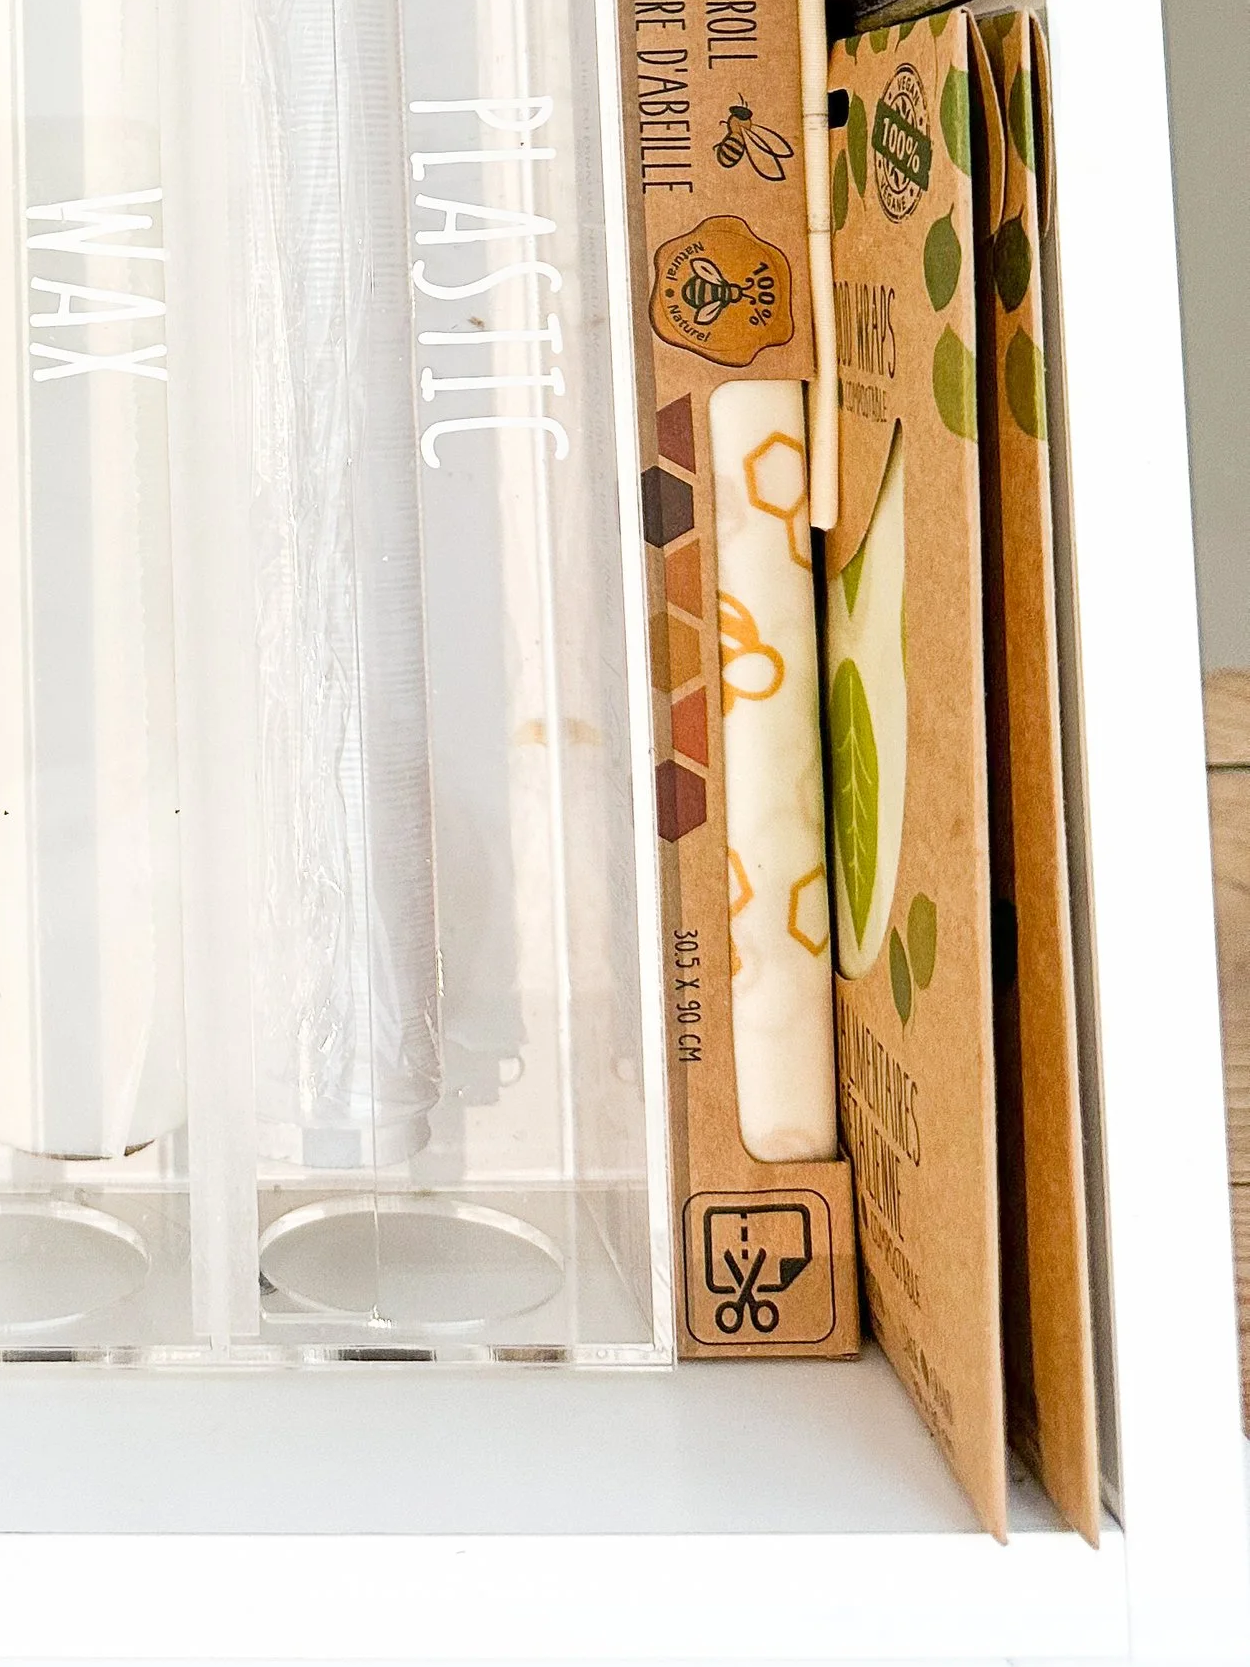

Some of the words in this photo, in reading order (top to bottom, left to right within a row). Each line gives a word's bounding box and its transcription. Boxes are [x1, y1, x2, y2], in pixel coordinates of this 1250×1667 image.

[706, 0, 759, 69] ROLL
[897, 75, 920, 106] VEGAN
[638, 49, 694, 195] D'ABEILLE
[883, 117, 920, 173] 100%
[880, 177, 907, 211] VEGANE
[666, 241, 705, 281] Natural
[26, 187, 168, 383] WAX
[408, 94, 569, 469] PLASTIC
[749, 262, 775, 326] 100%
[667, 304, 711, 342] Naturel
[856, 282, 896, 379] WRAPS
[674, 930, 700, 968] 30.5
[675, 979, 700, 990] X
[677, 1001, 701, 1023] 90
[679, 1035, 701, 1061] CM
